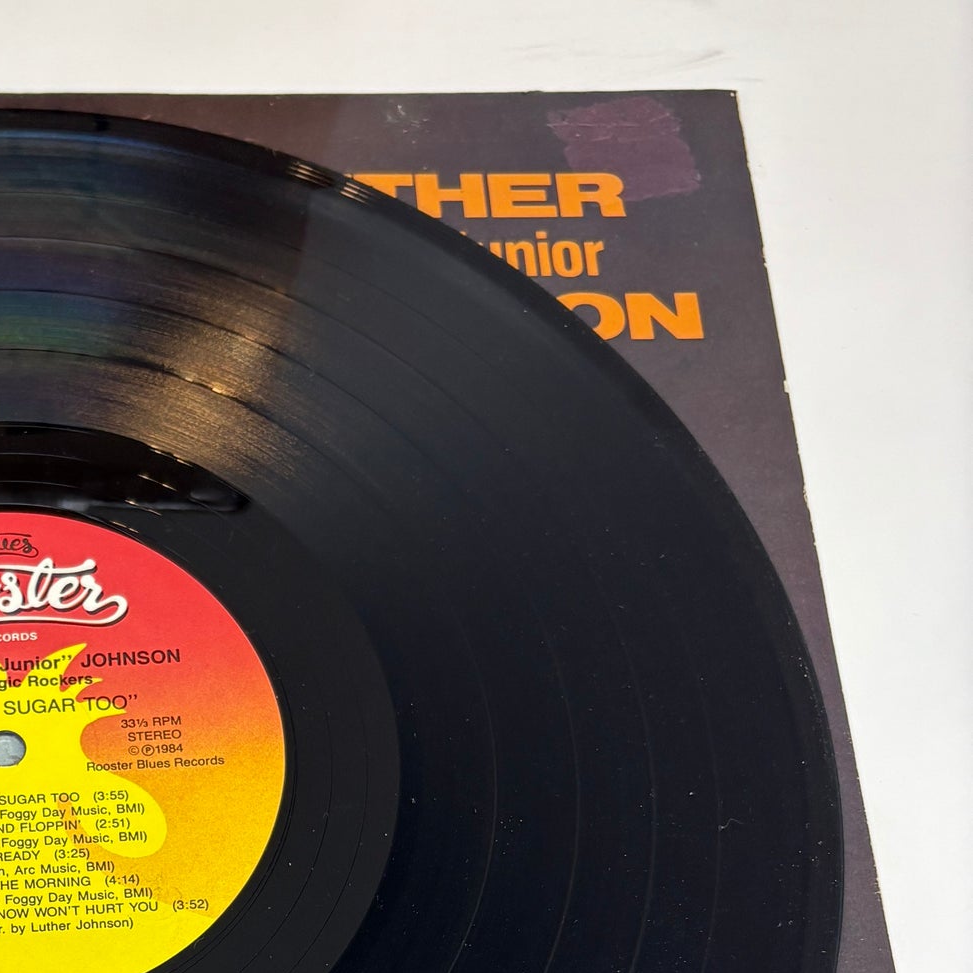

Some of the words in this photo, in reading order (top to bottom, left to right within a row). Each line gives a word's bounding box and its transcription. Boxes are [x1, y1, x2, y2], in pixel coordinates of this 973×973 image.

[80, 649, 181, 668] JOHNSON
[27, 674, 94, 687] Rockers
[2, 698, 76, 715] SUGAR
[82, 694, 138, 711] TOO"
[152, 716, 182, 726] RPM
[127, 730, 182, 742] STEREO
[86, 762, 134, 771] Rooster
[136, 758, 172, 769] Blues
[174, 756, 226, 767] Records
[50, 792, 80, 802] TOO
[92, 790, 130, 803] (3:55)
[0, 810, 38, 821] Foggy
[42, 808, 67, 819] Day
[70, 805, 112, 817] Music,
[116, 803, 146, 815] BMI)
[19, 820, 82, 832] FLOPPIN'
[95, 818, 131, 831] (2:51)
[1, 838, 40, 849] Foggy
[43, 836, 69, 847] Day
[72, 833, 114, 845] Music,
[118, 831, 148, 843] BMI)
[54, 848, 90, 861] (3:25)
[14, 866, 36, 875] Arc
[40, 863, 81, 875] Music,
[86, 861, 116, 873] BMI)
[24, 876, 92, 889] MORNING
[104, 874, 140, 887] (4:14)
[4, 894, 44, 906] Foggy
[48, 892, 73, 904] Day
[77, 890, 119, 902] Music,
[123, 888, 154, 899] BMI)
[33, 906, 81, 917] WON'T
[85, 903, 125, 914] HURT
[128, 902, 159, 912] YOU
[172, 899, 210, 912] (3:52)
[10, 923, 26, 936] by
[30, 922, 72, 932] Luther
[75, 917, 134, 930] Johnson)
